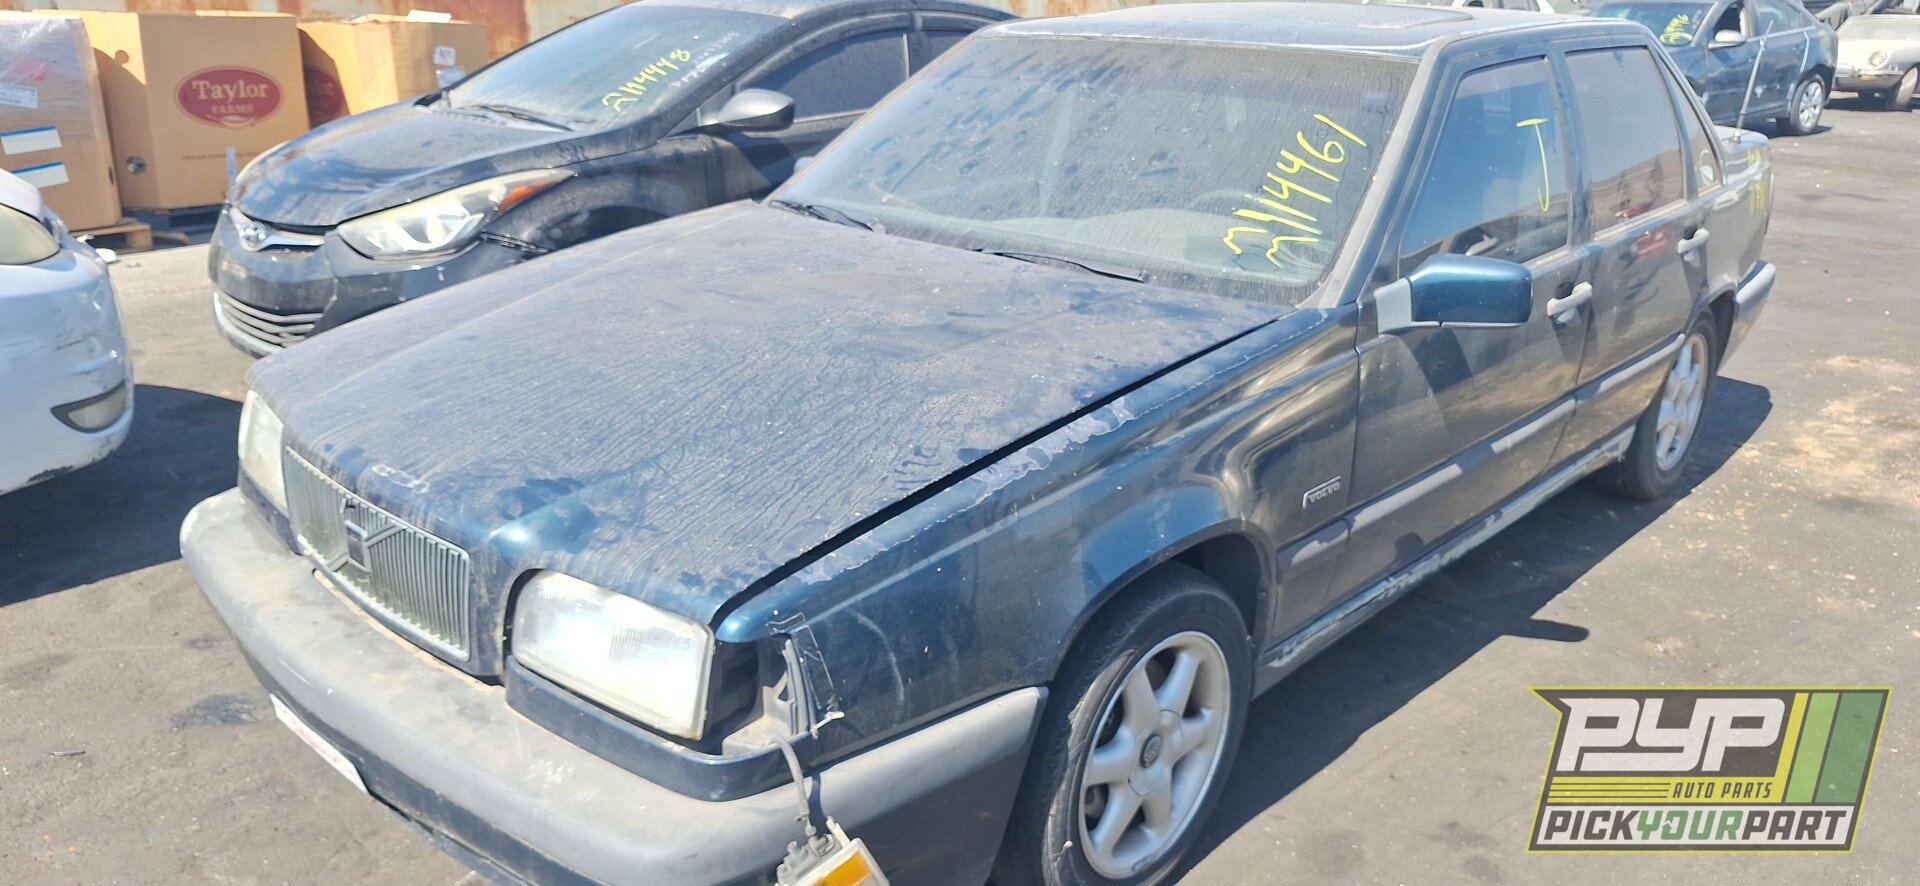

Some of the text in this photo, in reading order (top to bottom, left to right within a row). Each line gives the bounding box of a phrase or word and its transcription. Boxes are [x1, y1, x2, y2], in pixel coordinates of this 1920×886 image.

[191, 79, 269, 104] Taylor
[211, 103, 255, 114] FARMS
[1308, 481, 1340, 503] VOLVO
